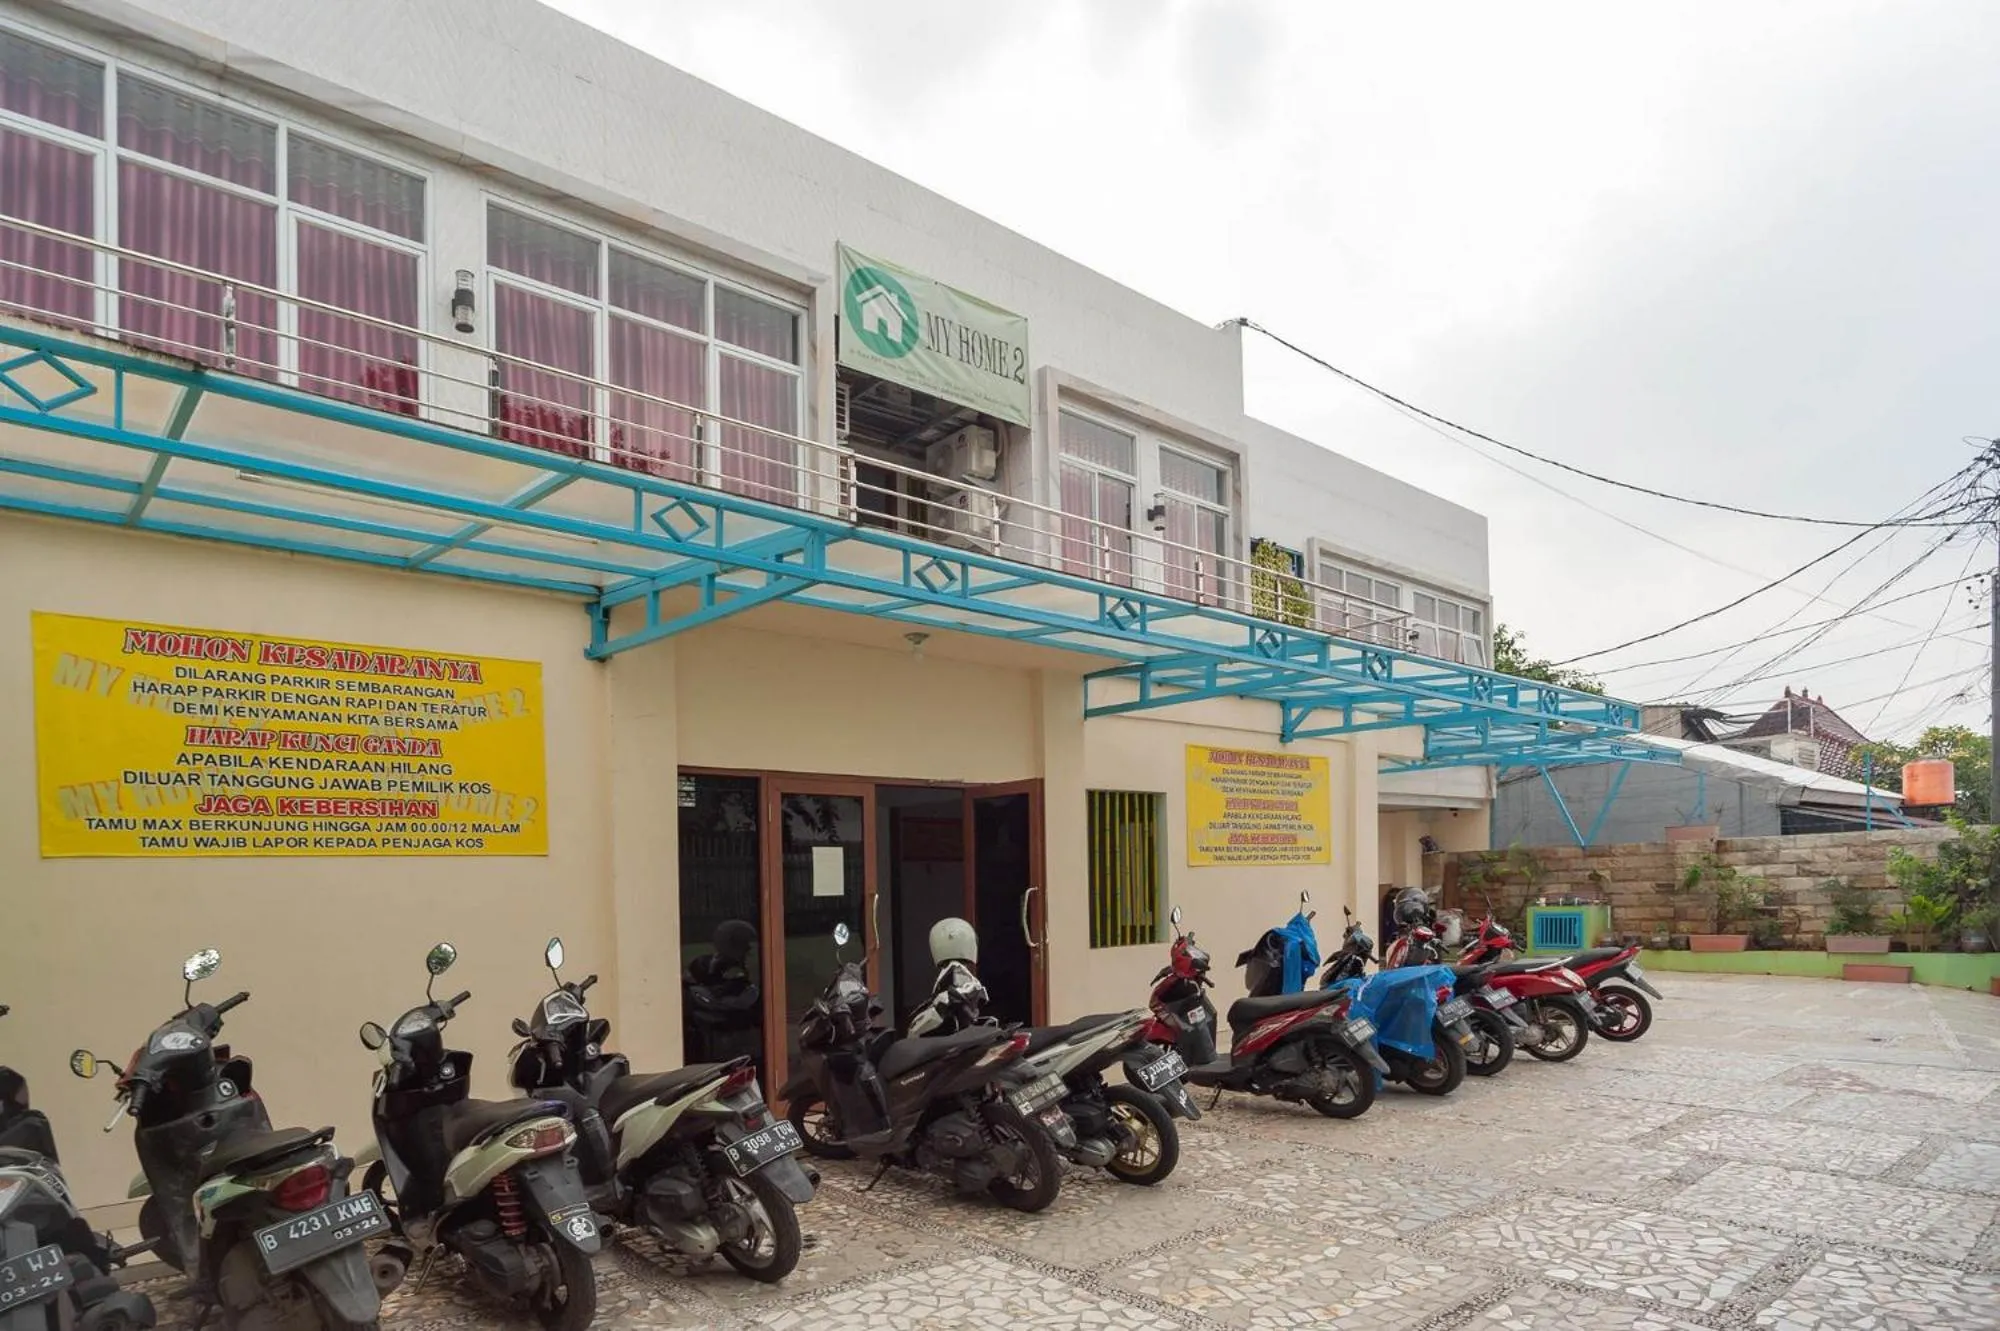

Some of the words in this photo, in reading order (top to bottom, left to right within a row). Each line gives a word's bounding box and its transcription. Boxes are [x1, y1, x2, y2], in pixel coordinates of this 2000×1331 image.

[925, 311, 952, 357] MY
[959, 325, 1009, 378] HOME
[1013, 347, 1025, 385] 2
[123, 628, 253, 661] MOHON
[259, 641, 482, 683] KESADARANYA
[175, 666, 266, 685] DILARANG
[271, 673, 331, 690] PARKIR
[335, 679, 455, 700] SEMBARANGAN
[132, 681, 198, 697] HARAP
[202, 687, 266, 702] PARKIR
[271, 692, 341, 708] DENGAN
[346, 697, 383, 711] RAPI
[387, 700, 417, 712] DAN
[421, 703, 487, 718] TERATUR
[173, 702, 219, 716] DEMI
[223, 705, 342, 724] KENYAMANAN
[347, 714, 379, 727] KITA
[384, 716, 459, 731] BERSAMA
[184, 725, 277, 750] HARAP
[278, 731, 361, 754] KUNCI
[361, 736, 443, 758] GANDA
[176, 753, 263, 769] APABILA
[268, 756, 385, 773] KENDARAAN
[391, 762, 453, 775] HILANG
[123, 770, 201, 786] DILUAR
[207, 774, 314, 790] TANGGUNG
[319, 778, 382, 792] JAWAB
[387, 780, 454, 794] PEMILIK
[459, 782, 492, 795] KOS
[194, 795, 273, 816] JAGA
[276, 796, 440, 819] KEBERSIHAN
[85, 817, 137, 831] TAMU
[143, 818, 183, 831] MAX
[189, 819, 308, 832] BERKUNJUNG
[312, 821, 371, 833] HINGGA
[376, 823, 407, 833] JAM
[411, 822, 468, 834] 00.00/12
[471, 823, 521, 834] MALAM
[139, 836, 189, 848] TAMU
[194, 837, 248, 848] WAJIB
[252, 837, 308, 848] LAPOR
[313, 838, 378, 848] KEPADA
[382, 838, 451, 849] PENJAGA
[455, 838, 484, 848] KOS
[728, 1148, 740, 1161] B
[743, 1132, 772, 1152] 3098
[263, 1234, 278, 1250] B
[289, 1213, 331, 1239] 4231
